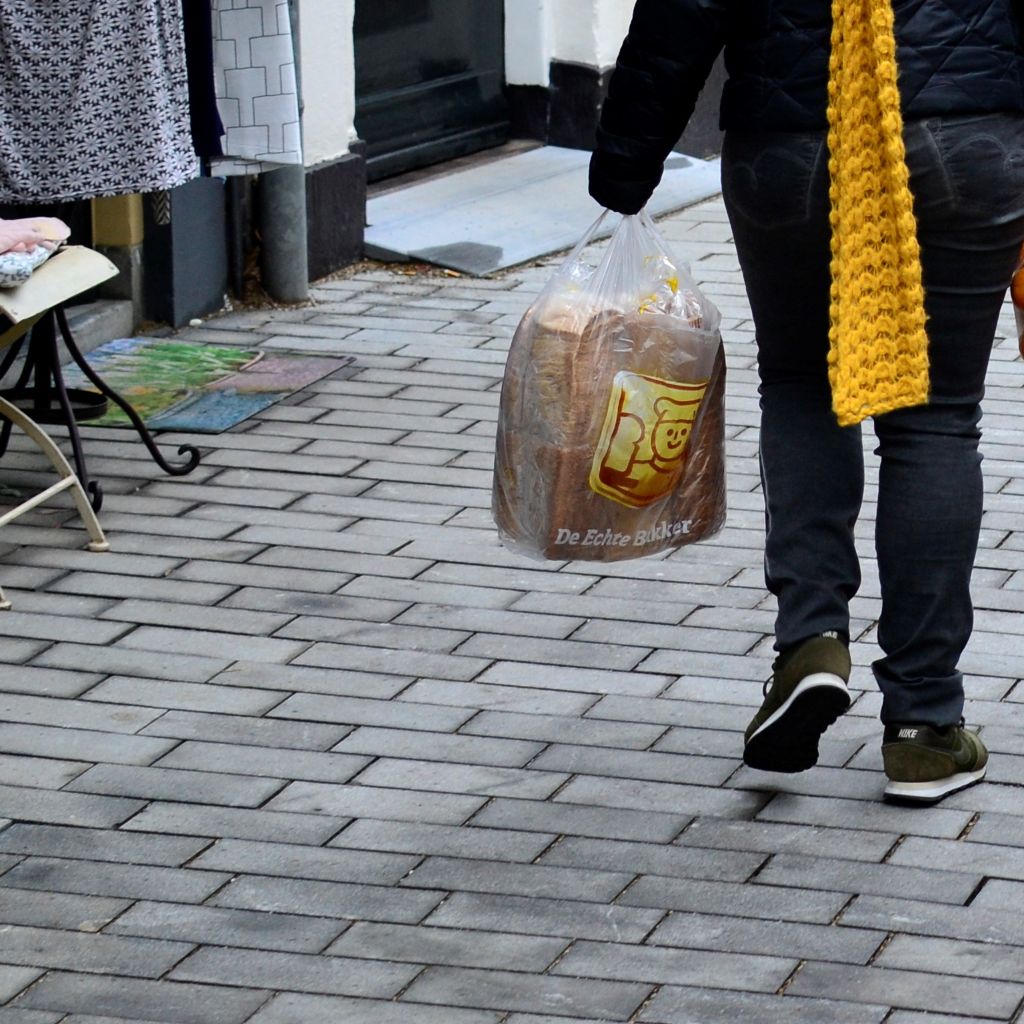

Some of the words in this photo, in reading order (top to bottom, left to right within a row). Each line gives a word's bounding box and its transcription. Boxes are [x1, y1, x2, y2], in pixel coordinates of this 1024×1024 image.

[555, 528, 580, 545] De
[581, 528, 632, 547] Echte
[898, 729, 918, 739] NIKE
